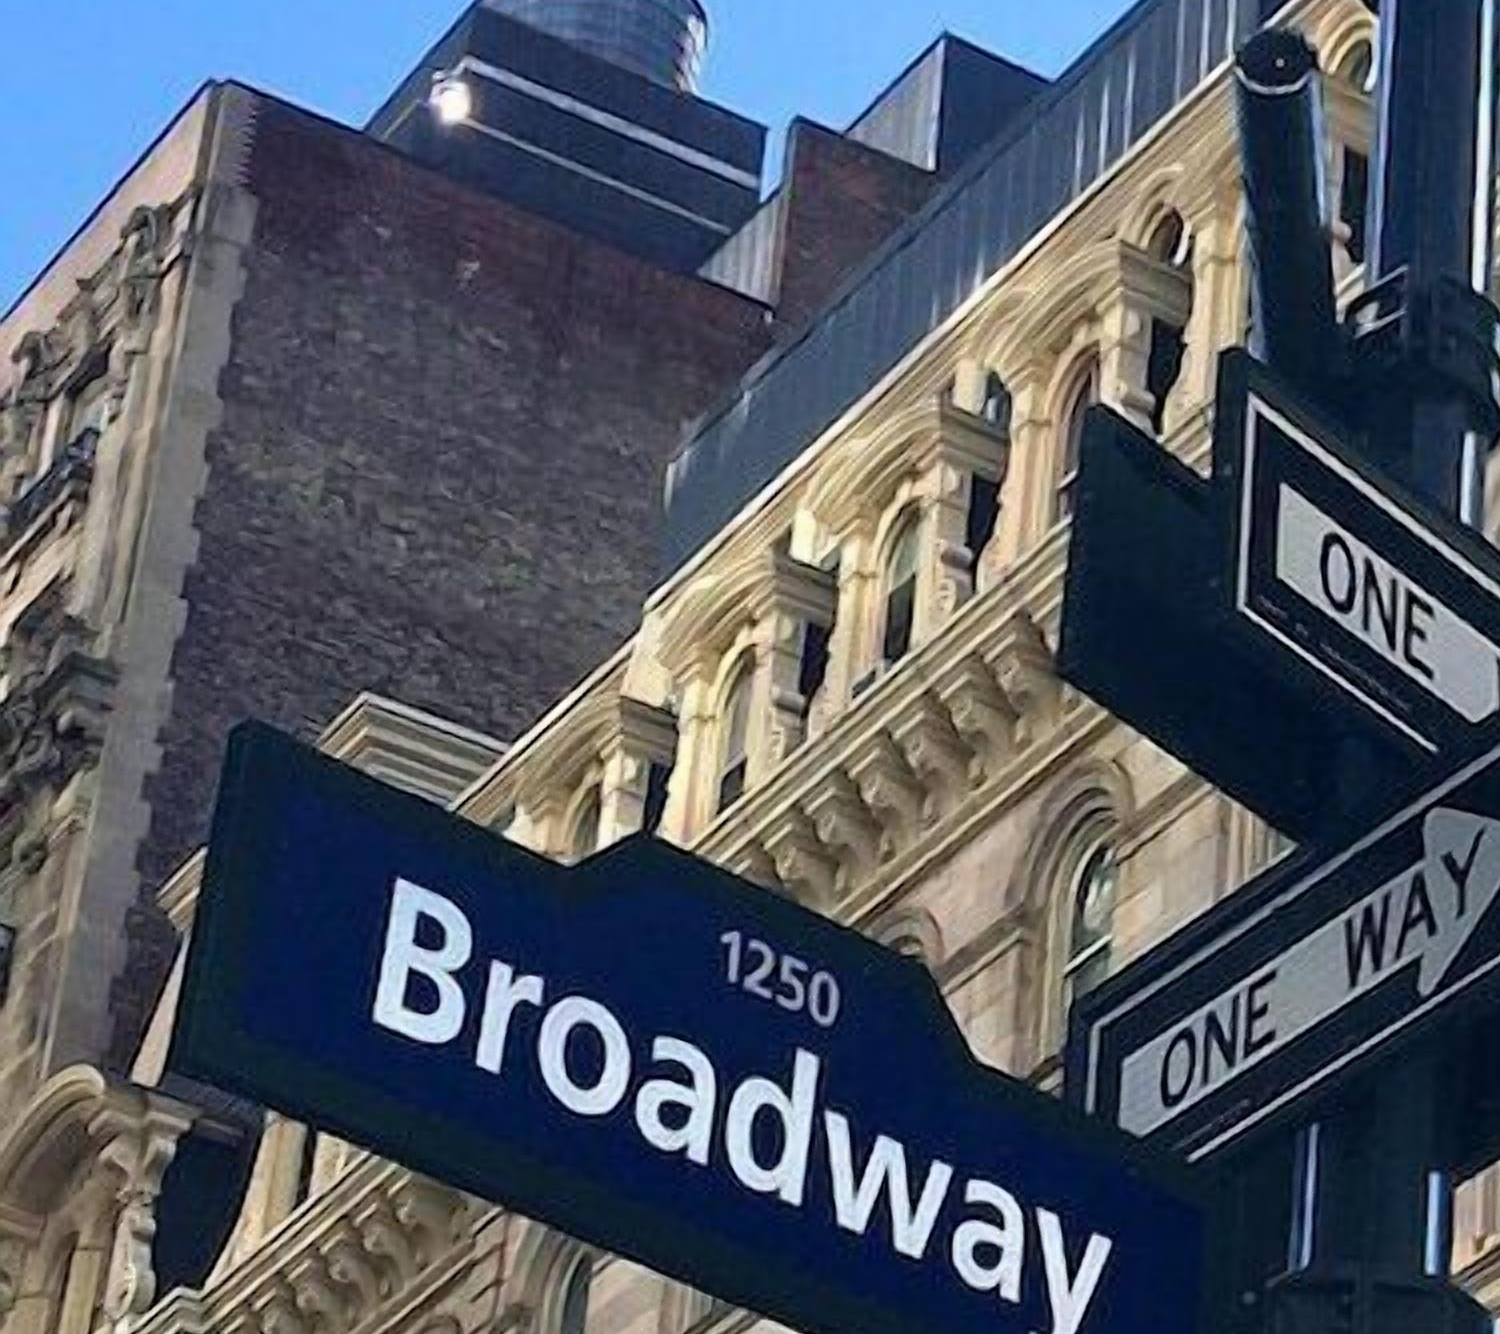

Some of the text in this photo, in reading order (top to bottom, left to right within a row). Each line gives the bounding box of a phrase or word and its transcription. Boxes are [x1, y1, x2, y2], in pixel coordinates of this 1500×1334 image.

[1319, 531, 1435, 680] ONE
[720, 930, 841, 1028] 1250
[1160, 827, 1484, 1107] ONE WAY
